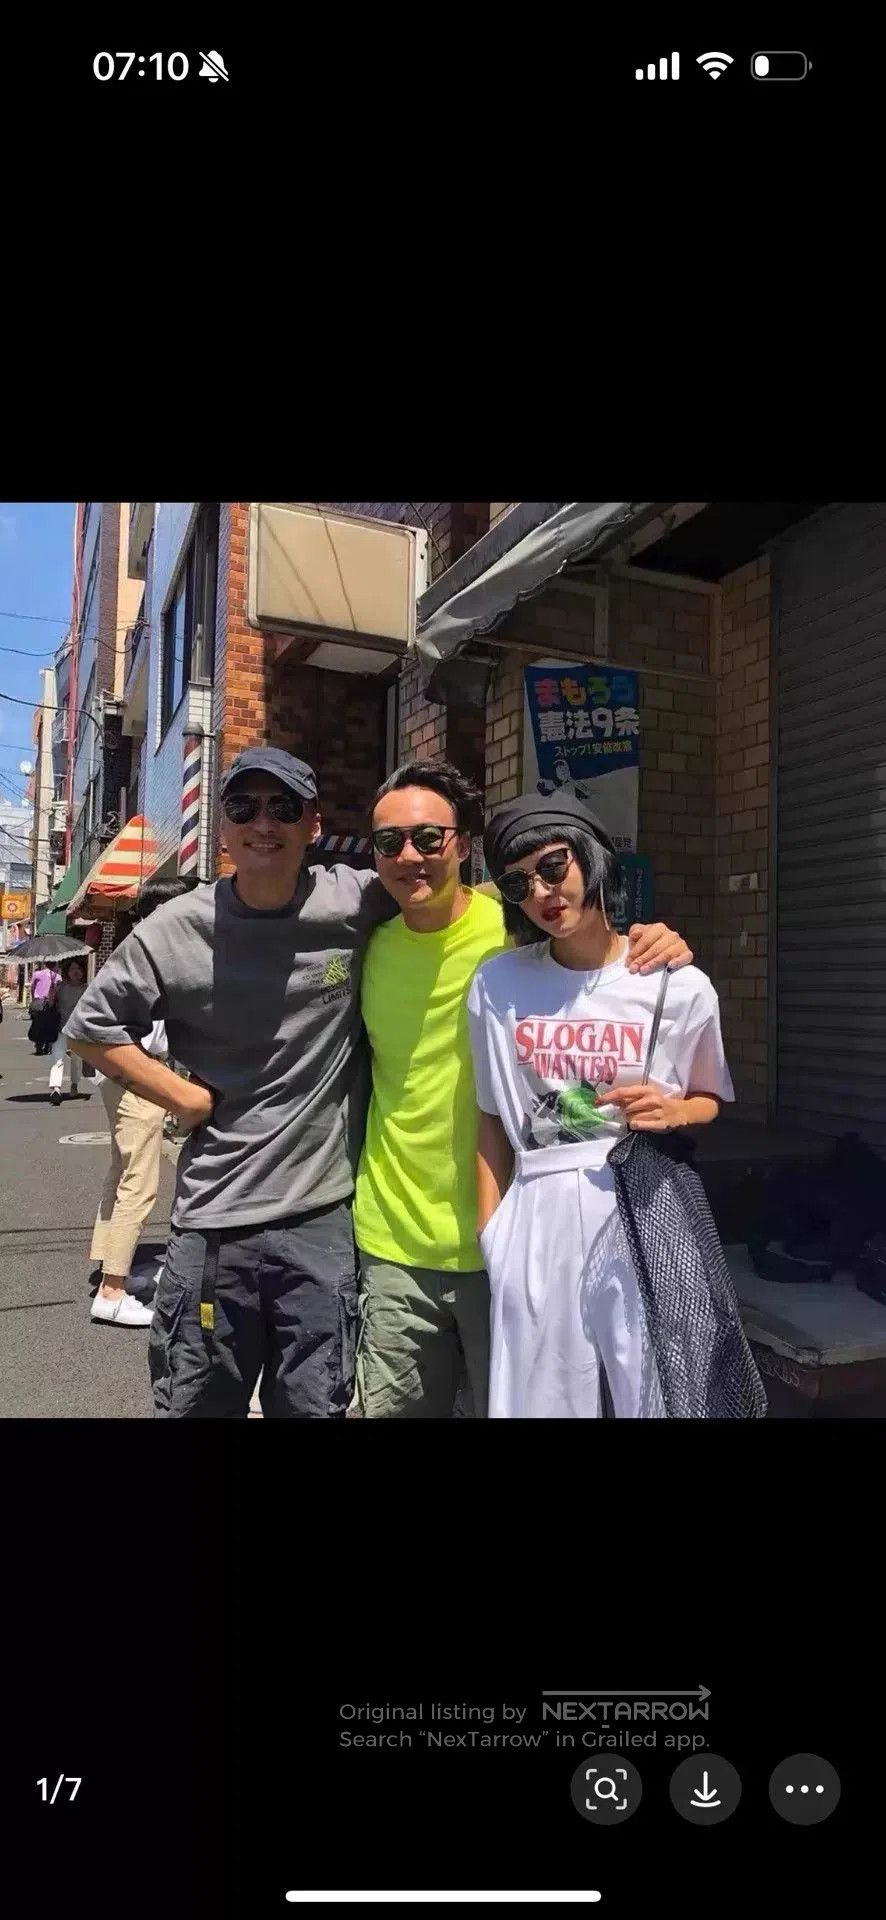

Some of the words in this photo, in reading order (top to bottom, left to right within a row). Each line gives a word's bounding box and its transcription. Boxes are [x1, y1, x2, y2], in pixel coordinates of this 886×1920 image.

[534, 676, 634, 705] まもろう
[537, 706, 640, 743] 憲法9条
[515, 1021, 644, 1063] SLOGAN
[533, 1053, 619, 1086] WANTED
